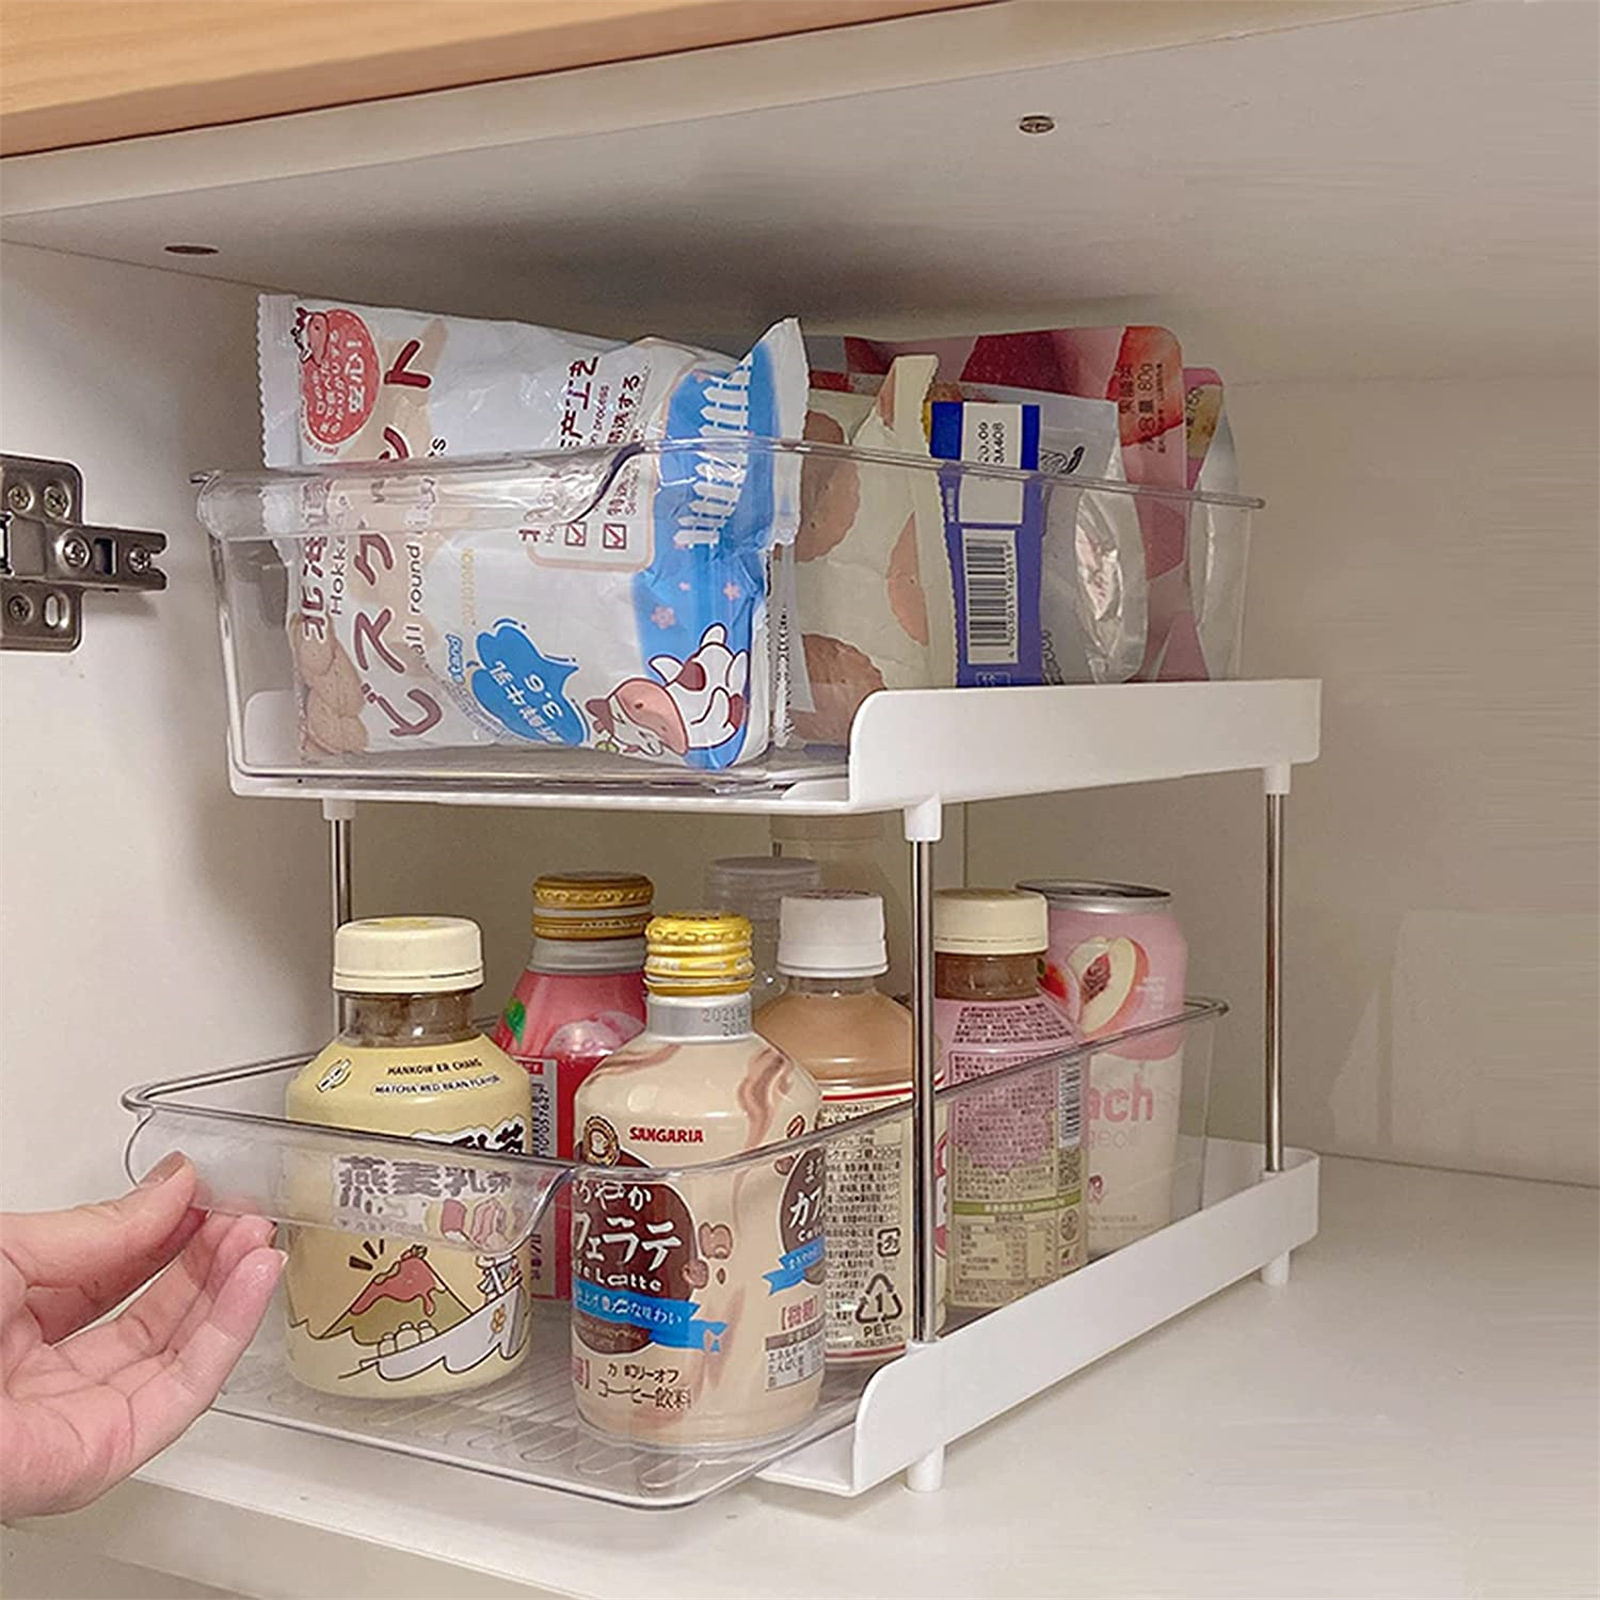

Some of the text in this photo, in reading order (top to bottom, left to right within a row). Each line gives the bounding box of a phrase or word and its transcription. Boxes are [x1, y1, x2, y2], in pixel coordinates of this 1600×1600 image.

[404, 544, 423, 614] round
[523, 673, 564, 720] 3.6
[628, 1125, 705, 1144] SANGARIA
[572, 1179, 653, 1212] ろやか
[572, 1211, 683, 1273] フェラテ
[595, 1266, 663, 1291] Latte
[874, 1292, 883, 1313] 1
[863, 1322, 892, 1338] PET
